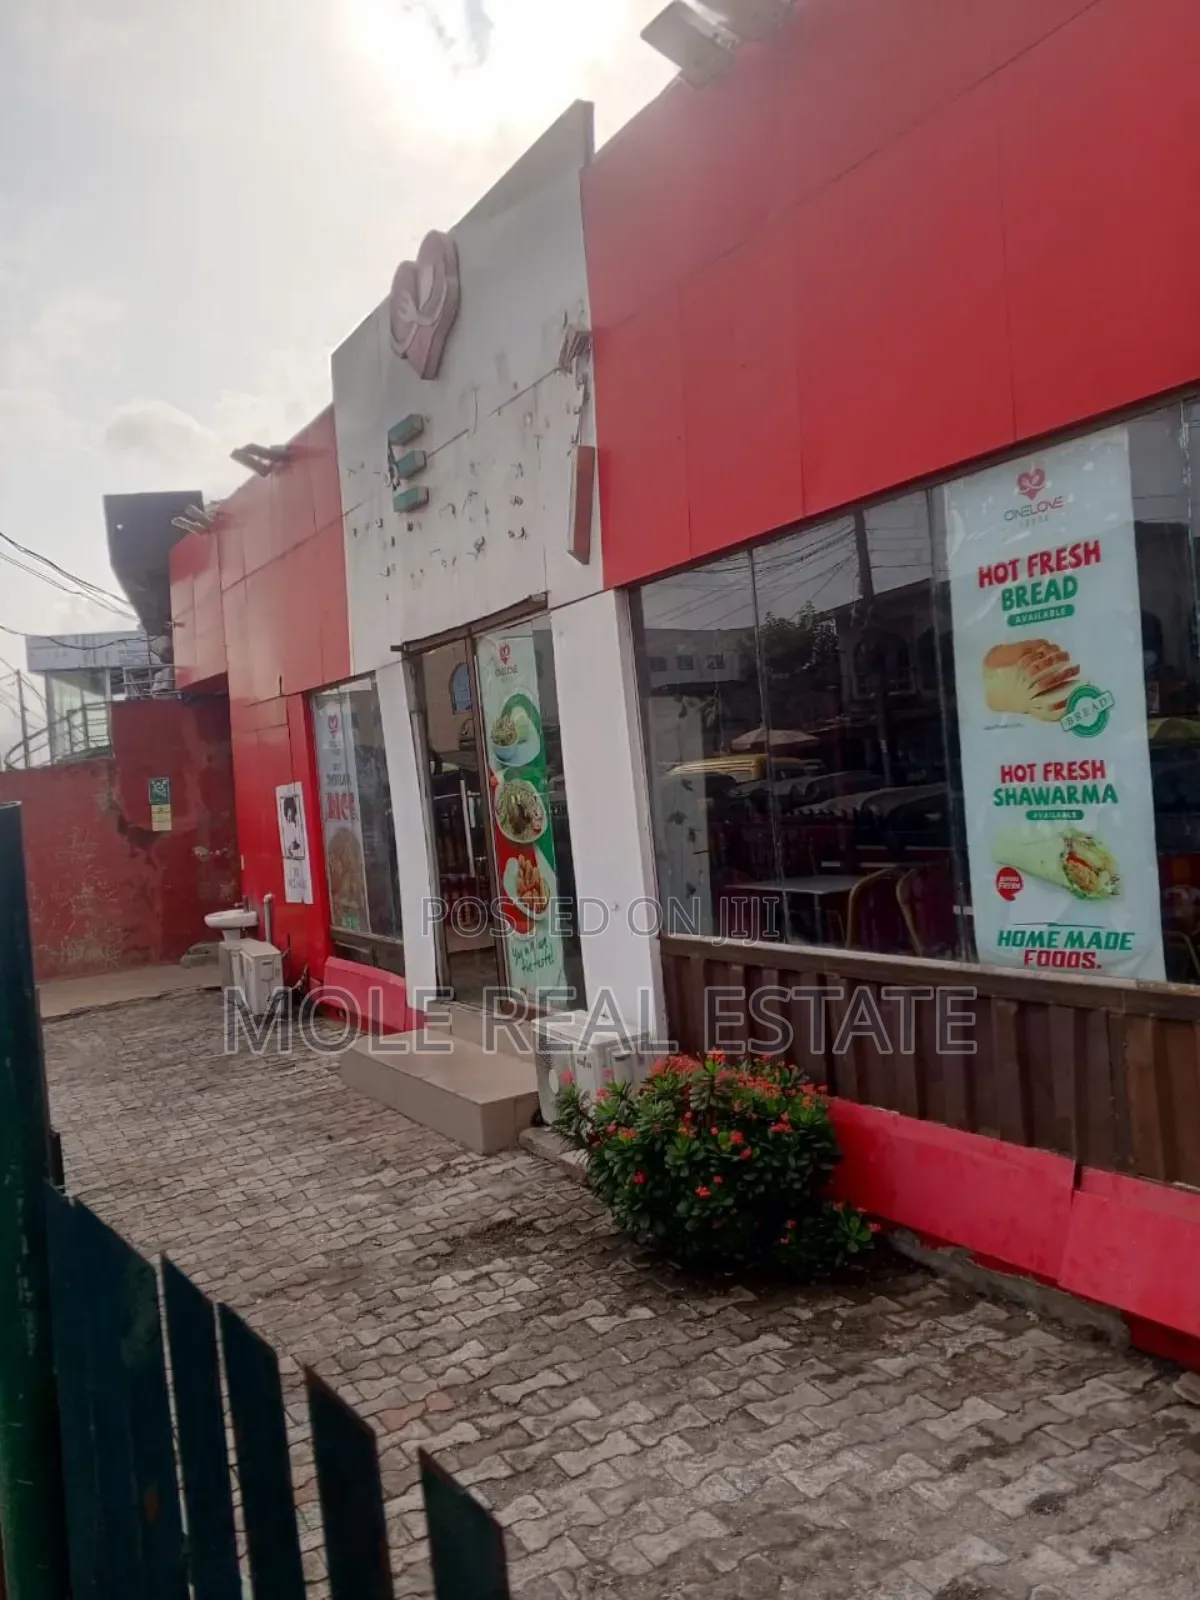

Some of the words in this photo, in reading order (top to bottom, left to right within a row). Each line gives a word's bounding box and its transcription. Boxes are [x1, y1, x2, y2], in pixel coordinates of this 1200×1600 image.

[1003, 496, 1065, 521] ONELOVE
[978, 558, 1021, 588] HOT
[1027, 540, 1101, 578] FRESH
[1001, 575, 1079, 612] BREAD
[1014, 607, 1066, 623] AVAILABLE
[1064, 696, 1109, 727] BREAD
[1000, 763, 1037, 784] HOT
[1043, 759, 1106, 782] FRESH
[993, 783, 1119, 806] SHAWARMA
[997, 930, 1061, 949] HOME
[1064, 931, 1135, 951] MADE
[1024, 950, 1103, 969] FOODS.
